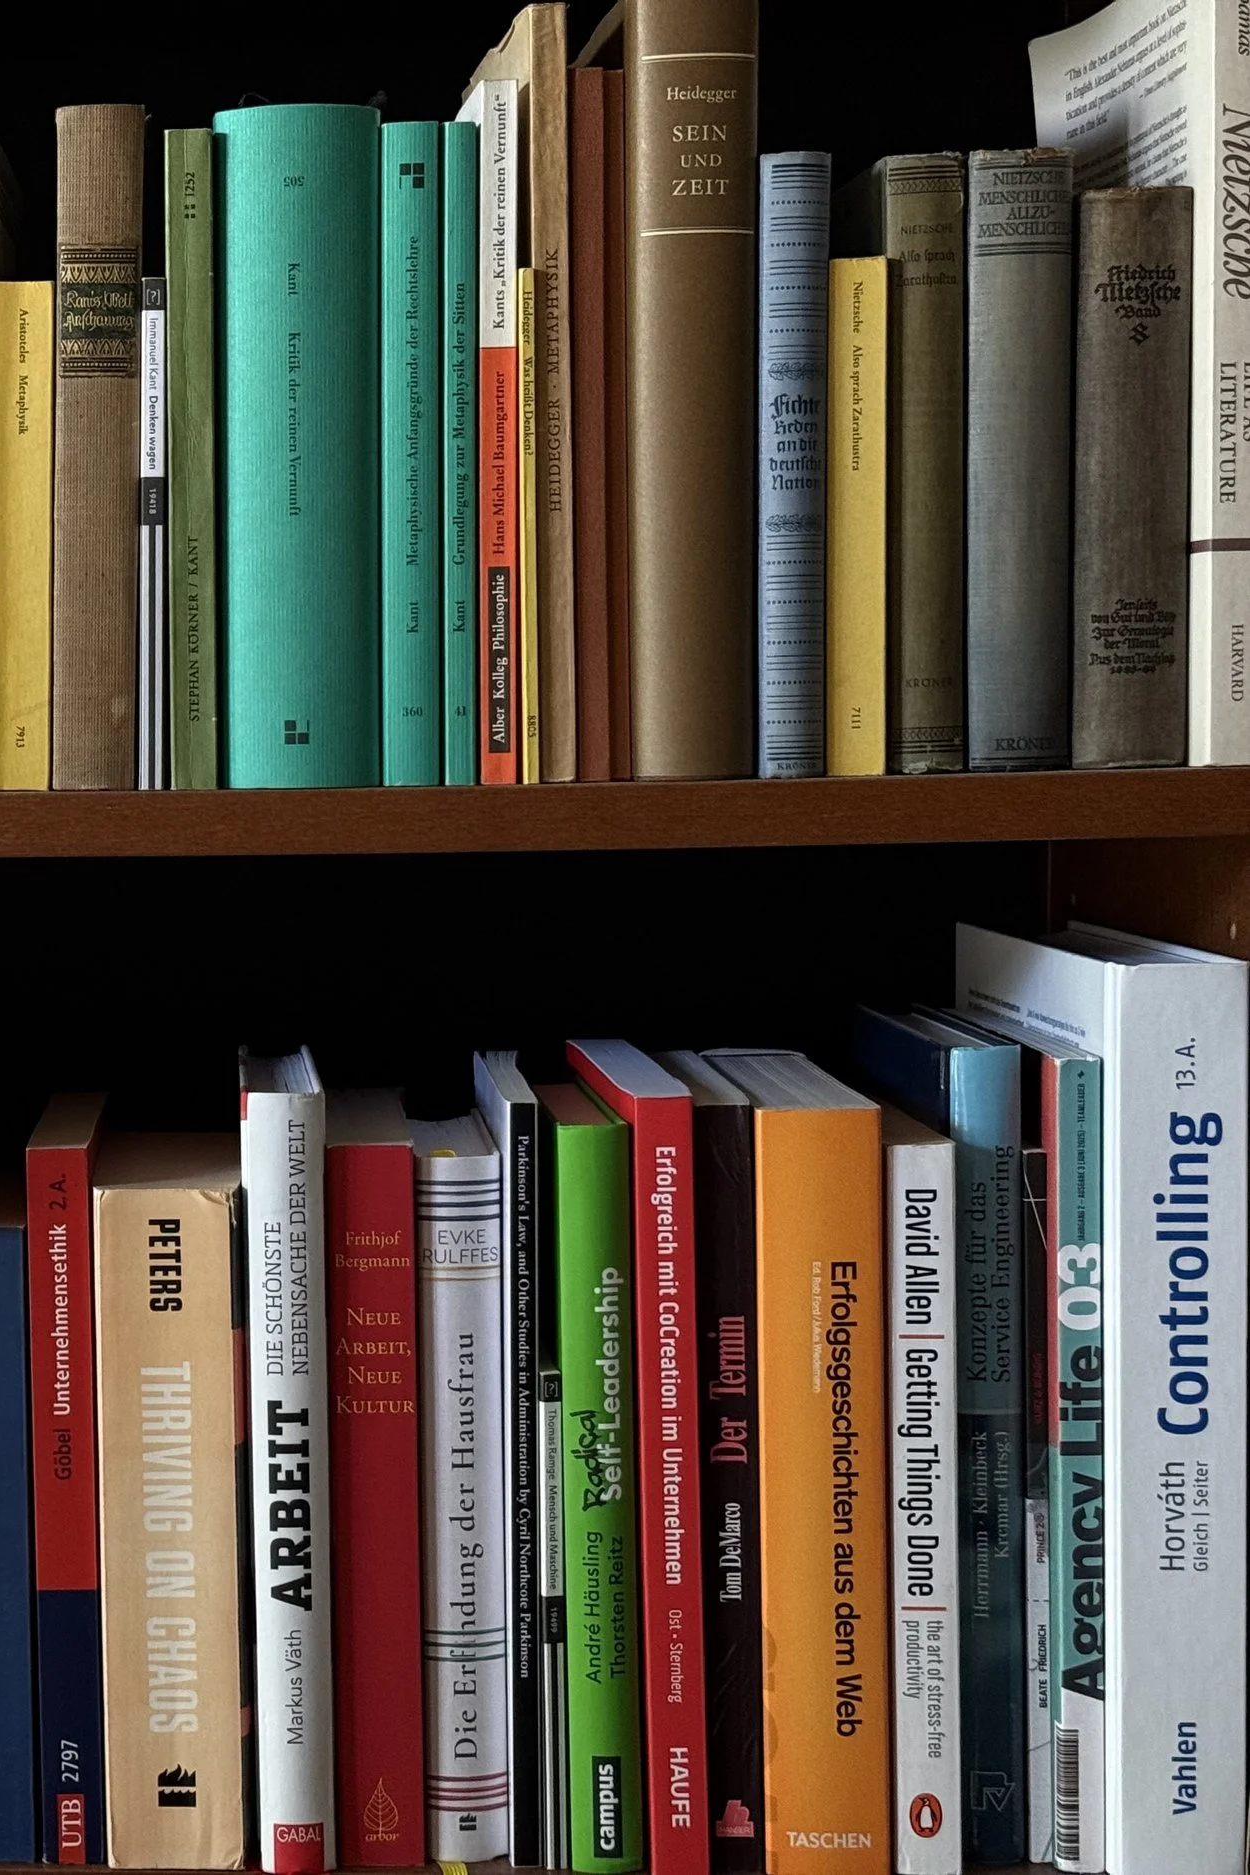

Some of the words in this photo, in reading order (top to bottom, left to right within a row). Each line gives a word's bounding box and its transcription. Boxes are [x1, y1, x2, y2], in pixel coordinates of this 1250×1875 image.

[667, 87, 737, 102] Heidegger
[672, 125, 727, 142] SEIN
[680, 154, 722, 168] UND
[185, 172, 195, 196] 1252
[493, 168, 505, 213] reinen
[672, 180, 729, 195] ZEIT
[493, 215, 505, 239] der
[493, 290, 504, 329] Kants
[853, 281, 863, 333] Nietzsche
[853, 345, 862, 363] Also
[852, 366, 862, 404] sprach
[851, 408, 863, 471] Zarathustra
[1219, 362, 1237, 504] LITERATURE
[188, 536, 199, 575] KANT
[188, 593, 199, 654] KÖRNER
[189, 661, 200, 722] STEPHAN
[1230, 624, 1244, 702] HARVARD
[852, 707, 861, 729] 7111
[651, 1146, 677, 1255] Erfolgreich
[905, 1190, 939, 1258] David
[148, 1219, 182, 1311] PETERS
[335, 1253, 410, 1270] Bergmann
[346, 1231, 401, 1247] Frithjof
[423, 1247, 498, 1265] RULFFES
[438, 1229, 486, 1245] EVKE
[659, 1262, 679, 1296] mit
[905, 1265, 939, 1325] Allen
[1057, 1243, 1101, 1330] 03
[1154, 1112, 1223, 1435] Controlling
[49, 1223, 71, 1416] Unternehmensethik
[659, 1302, 681, 1410] CoCreation
[448, 1333, 474, 1470] Hausfrau
[823, 1262, 859, 1534] Erfolgsgeschichten
[898, 1349, 939, 1437] Getting
[1060, 1345, 1103, 1455] Life
[54, 1428, 70, 1481] Göbel
[140, 1361, 193, 1532] THRIVING
[661, 1415, 682, 1441] im
[570, 1410, 605, 1511] Radical
[898, 1444, 939, 1526] Things
[267, 1400, 312, 1611] ARBEIT
[449, 1484, 475, 1532] der
[662, 1448, 681, 1585] Unternehmen
[1159, 1461, 1185, 1571] Horváth
[145, 1551, 195, 1598] ON
[834, 1543, 853, 1593] aus
[907, 1536, 939, 1597] Done
[1061, 1473, 1105, 1701] Agency
[449, 1542, 483, 1695] Erfindung
[834, 1603, 861, 1665] dem
[1038, 1625, 1046, 1671] FRIEDRICH
[146, 1617, 198, 1733] CHAOS
[285, 1629, 302, 1674] Väth
[287, 1677, 303, 1745] Markus
[835, 1674, 862, 1736] Web
[1039, 1679, 1047, 1708] BEATE
[61, 1740, 79, 1782] 2797
[454, 1710, 477, 1759] Die
[669, 1747, 690, 1828] HAUFE
[1172, 1722, 1196, 1815] Vahlen
[277, 1826, 323, 1843] GABAL
[598, 1764, 618, 1851] campus
[787, 1831, 871, 1849] TASCHEN
